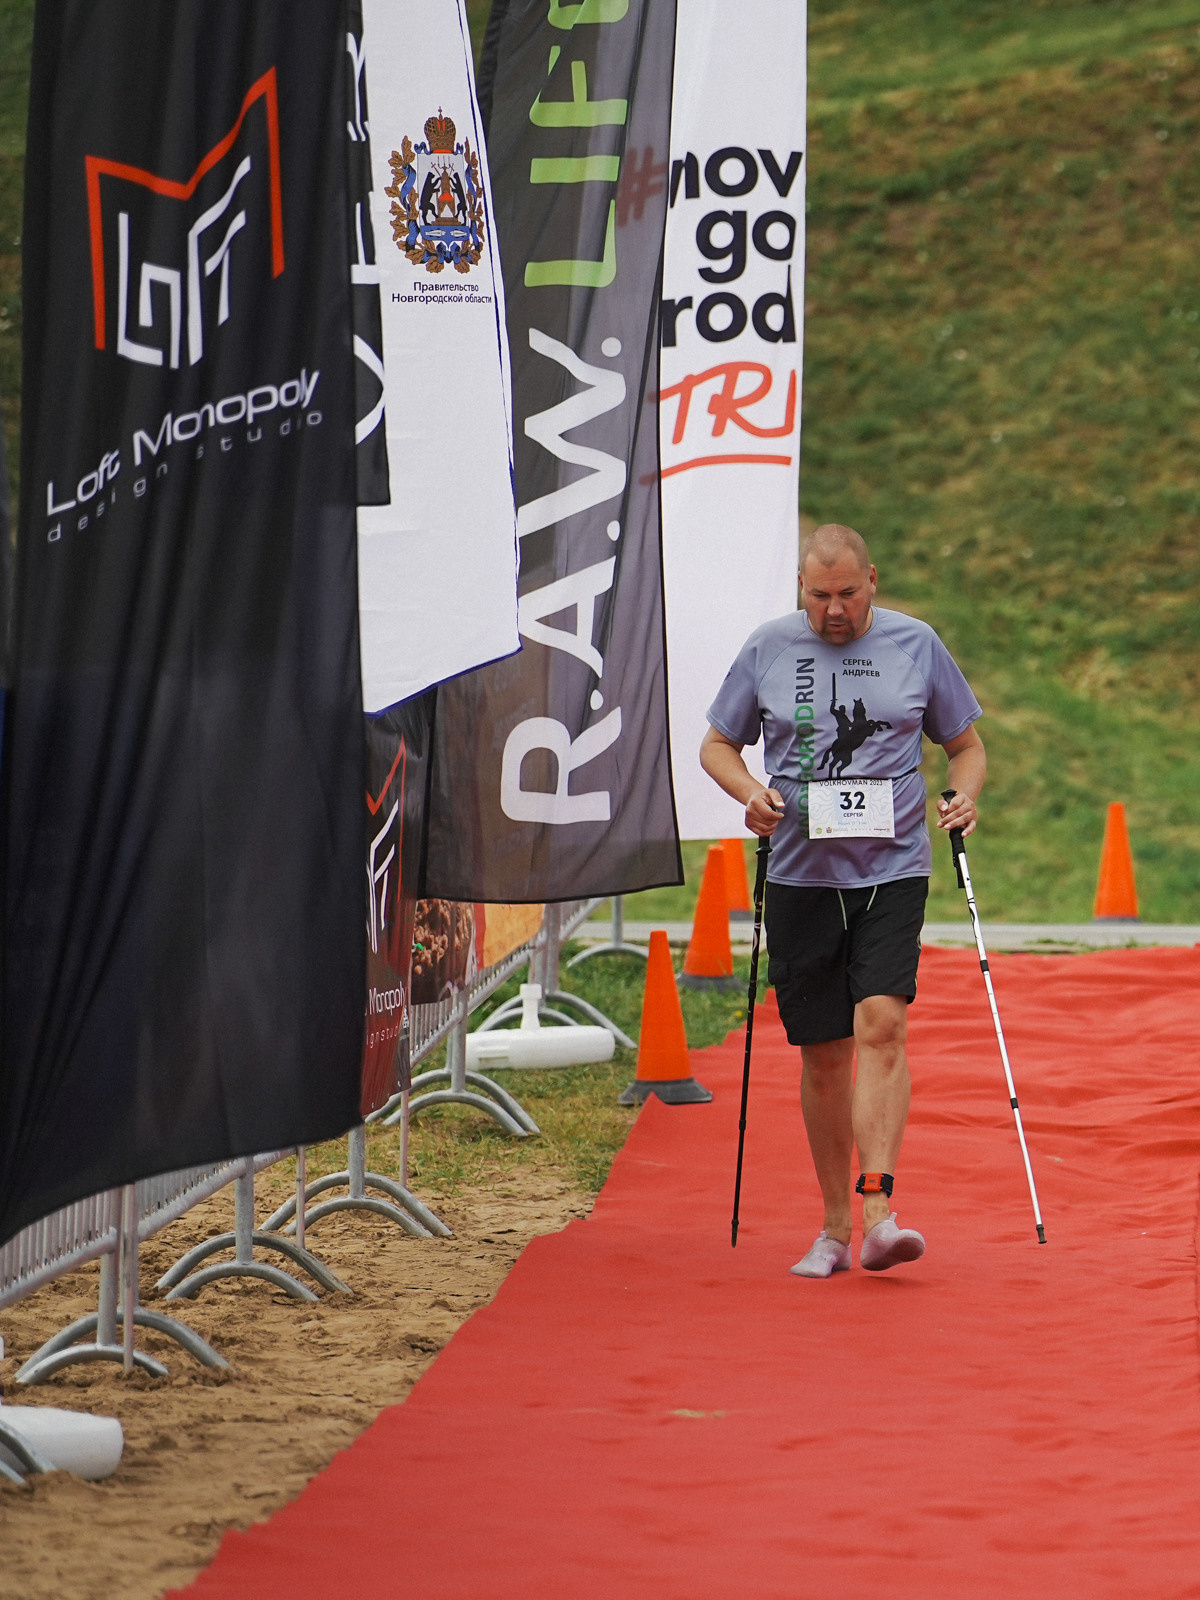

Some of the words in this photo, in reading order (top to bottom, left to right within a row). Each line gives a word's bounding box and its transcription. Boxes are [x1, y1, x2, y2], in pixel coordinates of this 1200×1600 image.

[695, 210, 796, 284] go
[413, 281, 479, 293] Правительство
[391, 293, 463, 305] Новгородской
[464, 293, 492, 303] области
[662, 265, 797, 347] rod
[46, 449, 121, 516] Loft
[132, 367, 320, 467] Monopoly
[47, 462, 168, 543] design
[842, 658, 873, 667] СЕРГЕЙ
[842, 669, 881, 678] АНДРЕЕВ
[820, 779, 868, 787] VOLKHOVMAN
[839, 791, 866, 810] 32
